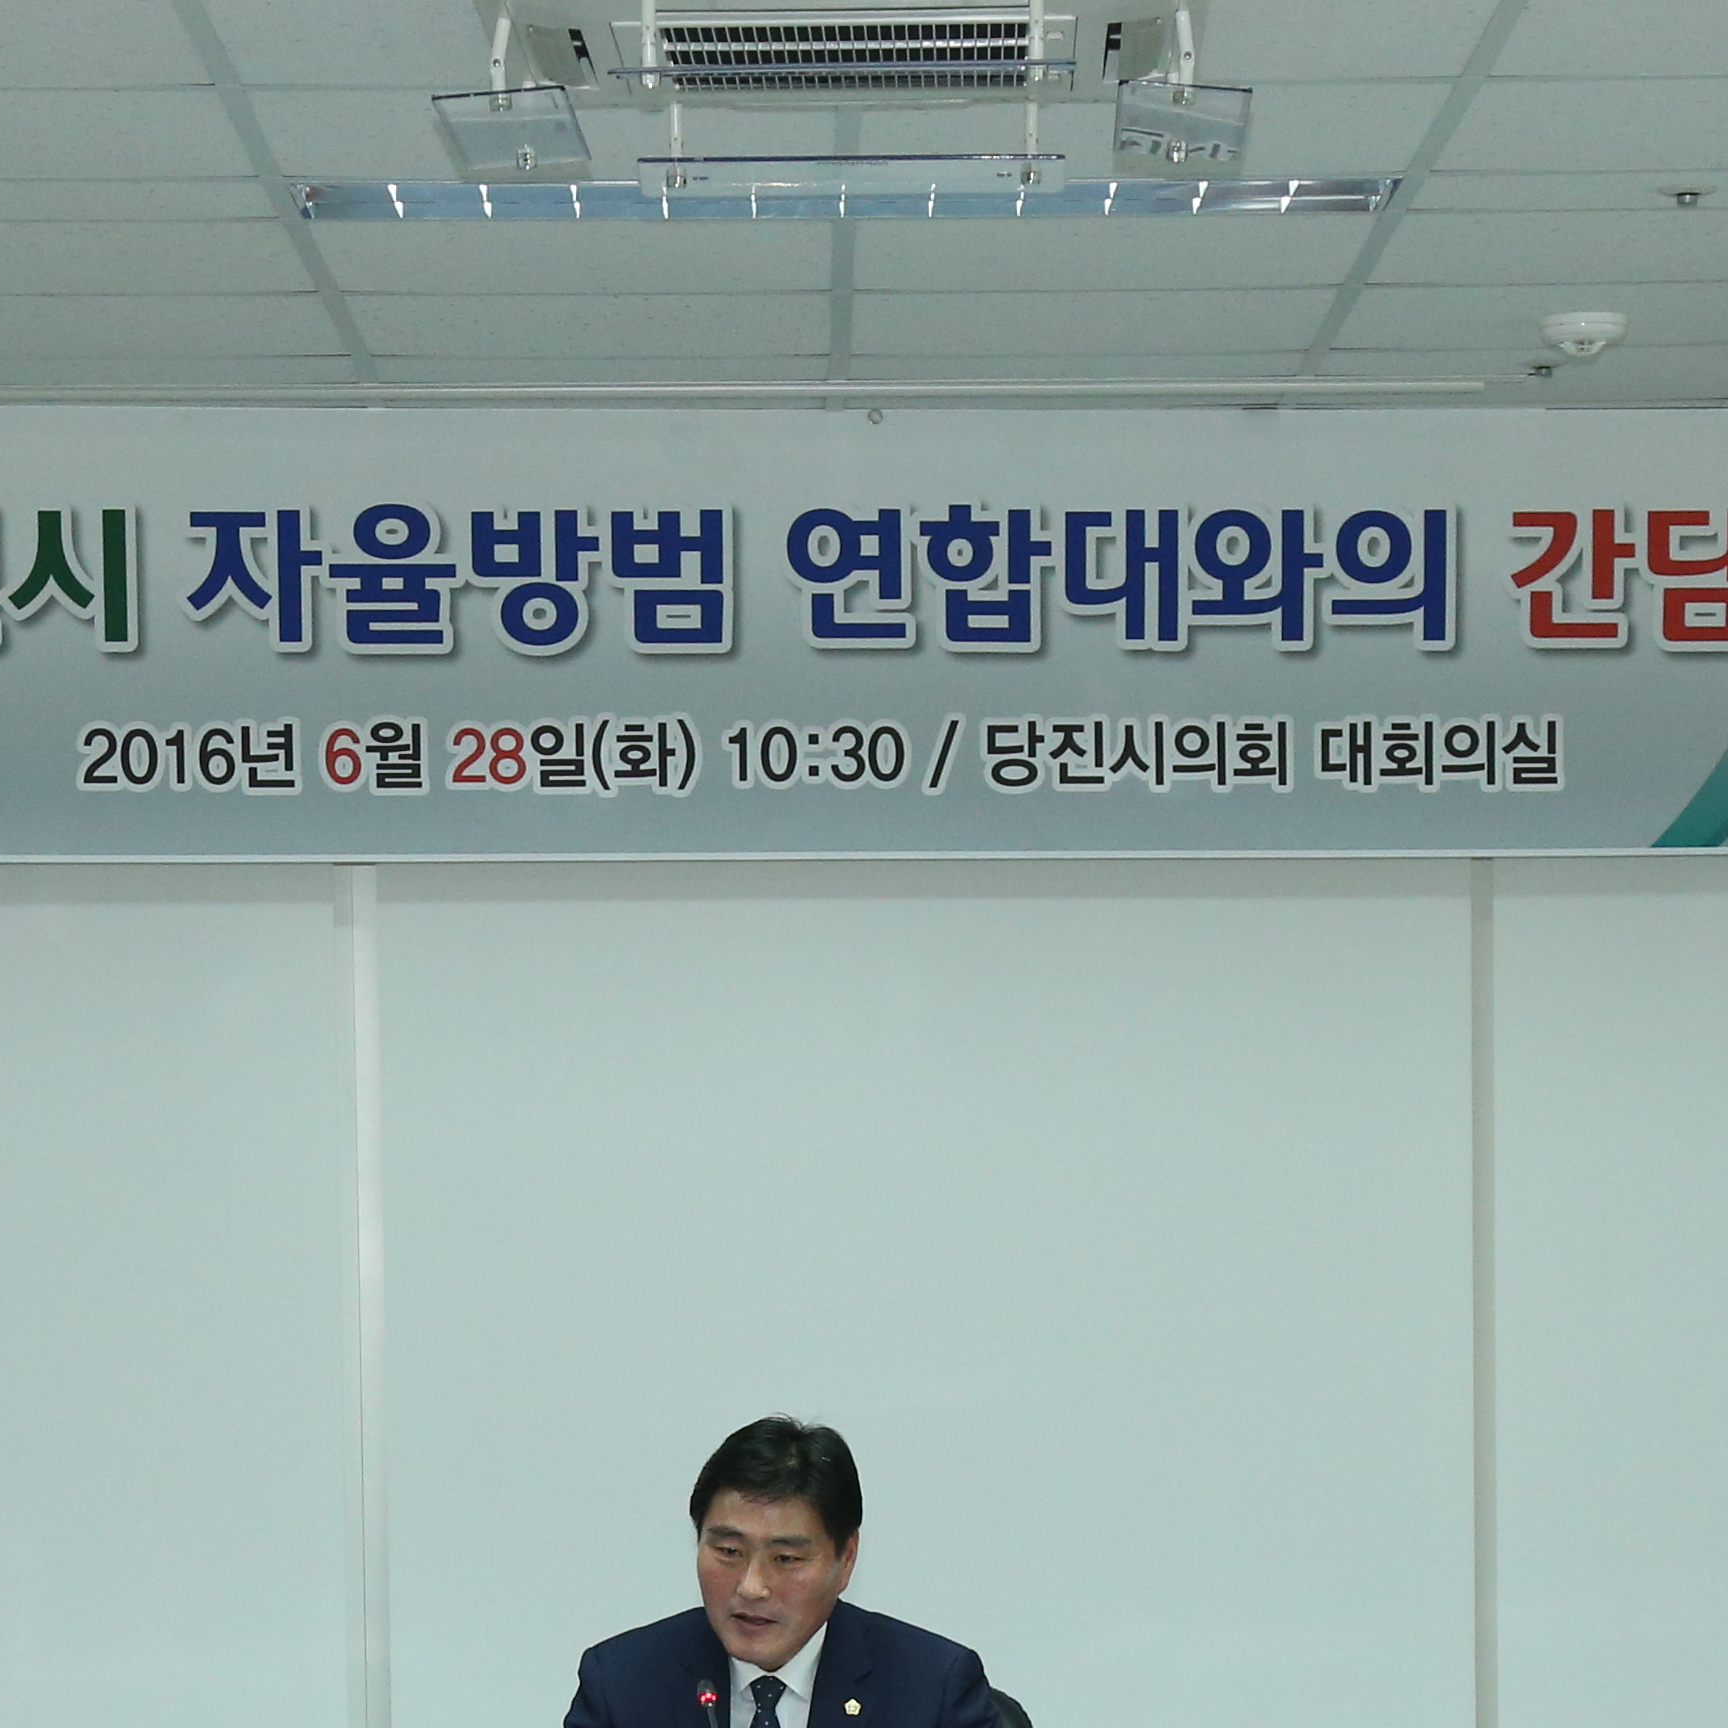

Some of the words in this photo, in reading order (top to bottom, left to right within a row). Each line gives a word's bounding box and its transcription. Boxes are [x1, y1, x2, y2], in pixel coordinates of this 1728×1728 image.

[184, 500, 728, 648] 자율방범
[792, 504, 1450, 648] 연합대와의
[82, 724, 297, 789] 2016년
[323, 724, 424, 789] 6월
[450, 723, 698, 794] 28일(화)
[727, 723, 906, 784] 10:30
[984, 719, 1281, 788] 당진시의회
[1320, 719, 1561, 788] 대회의실
